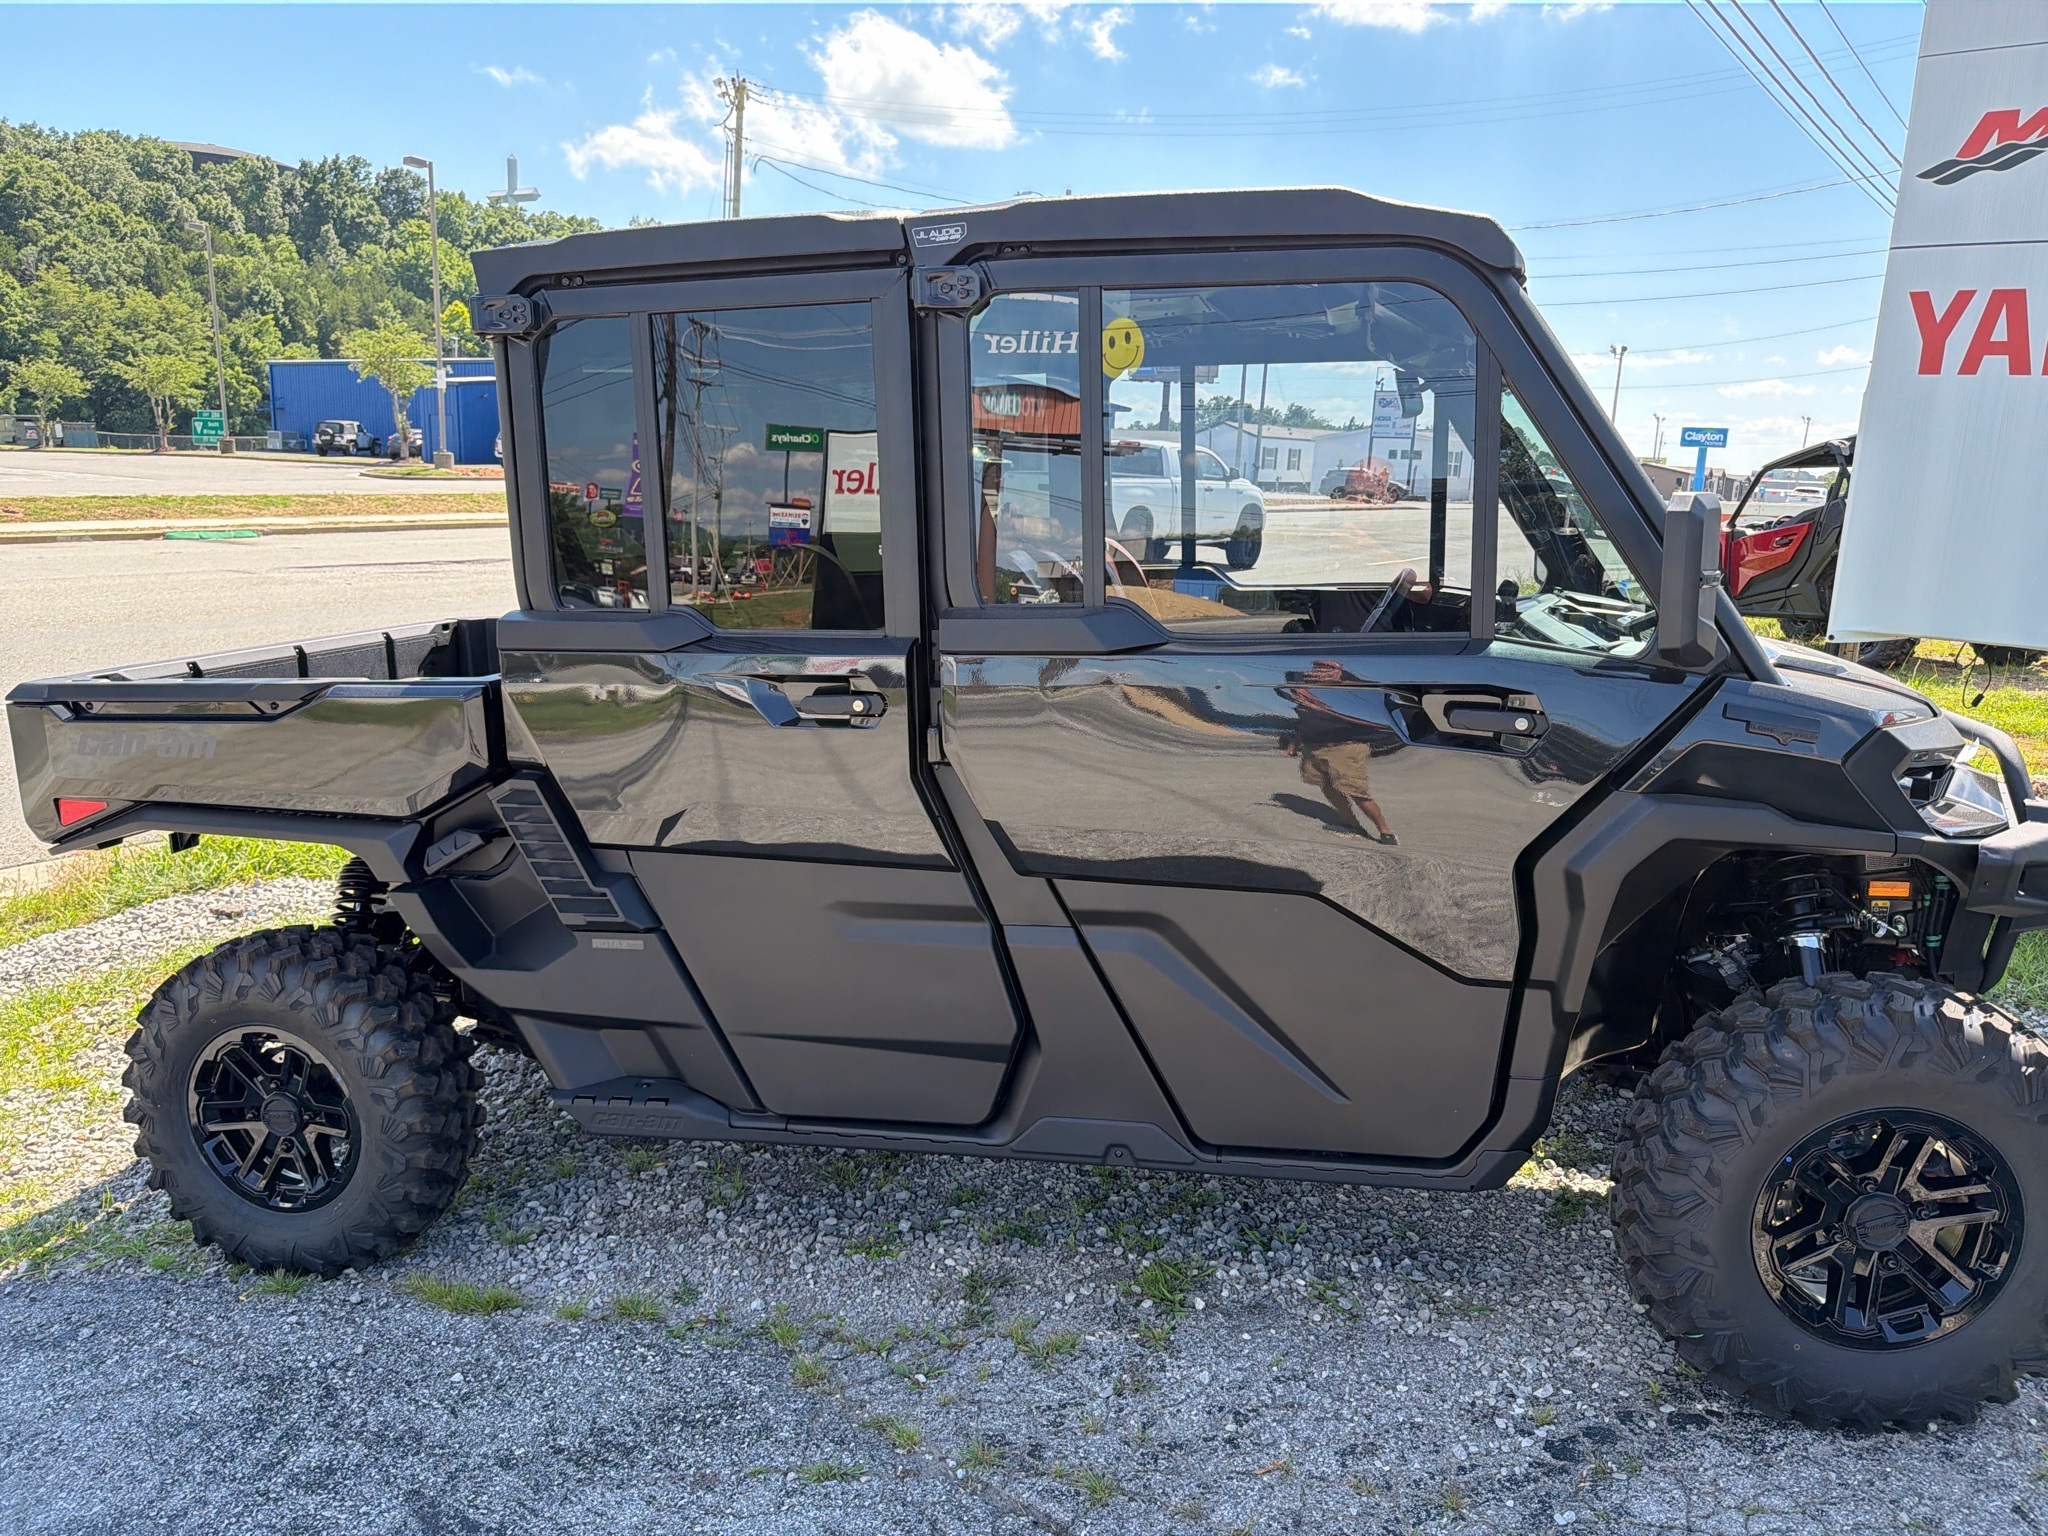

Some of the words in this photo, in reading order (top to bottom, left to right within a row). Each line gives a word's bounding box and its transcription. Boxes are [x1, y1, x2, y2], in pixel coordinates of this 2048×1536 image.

[916, 231, 928, 239] JL
[1909, 288, 2048, 376] YA
[1684, 431, 1724, 443] Clayton
